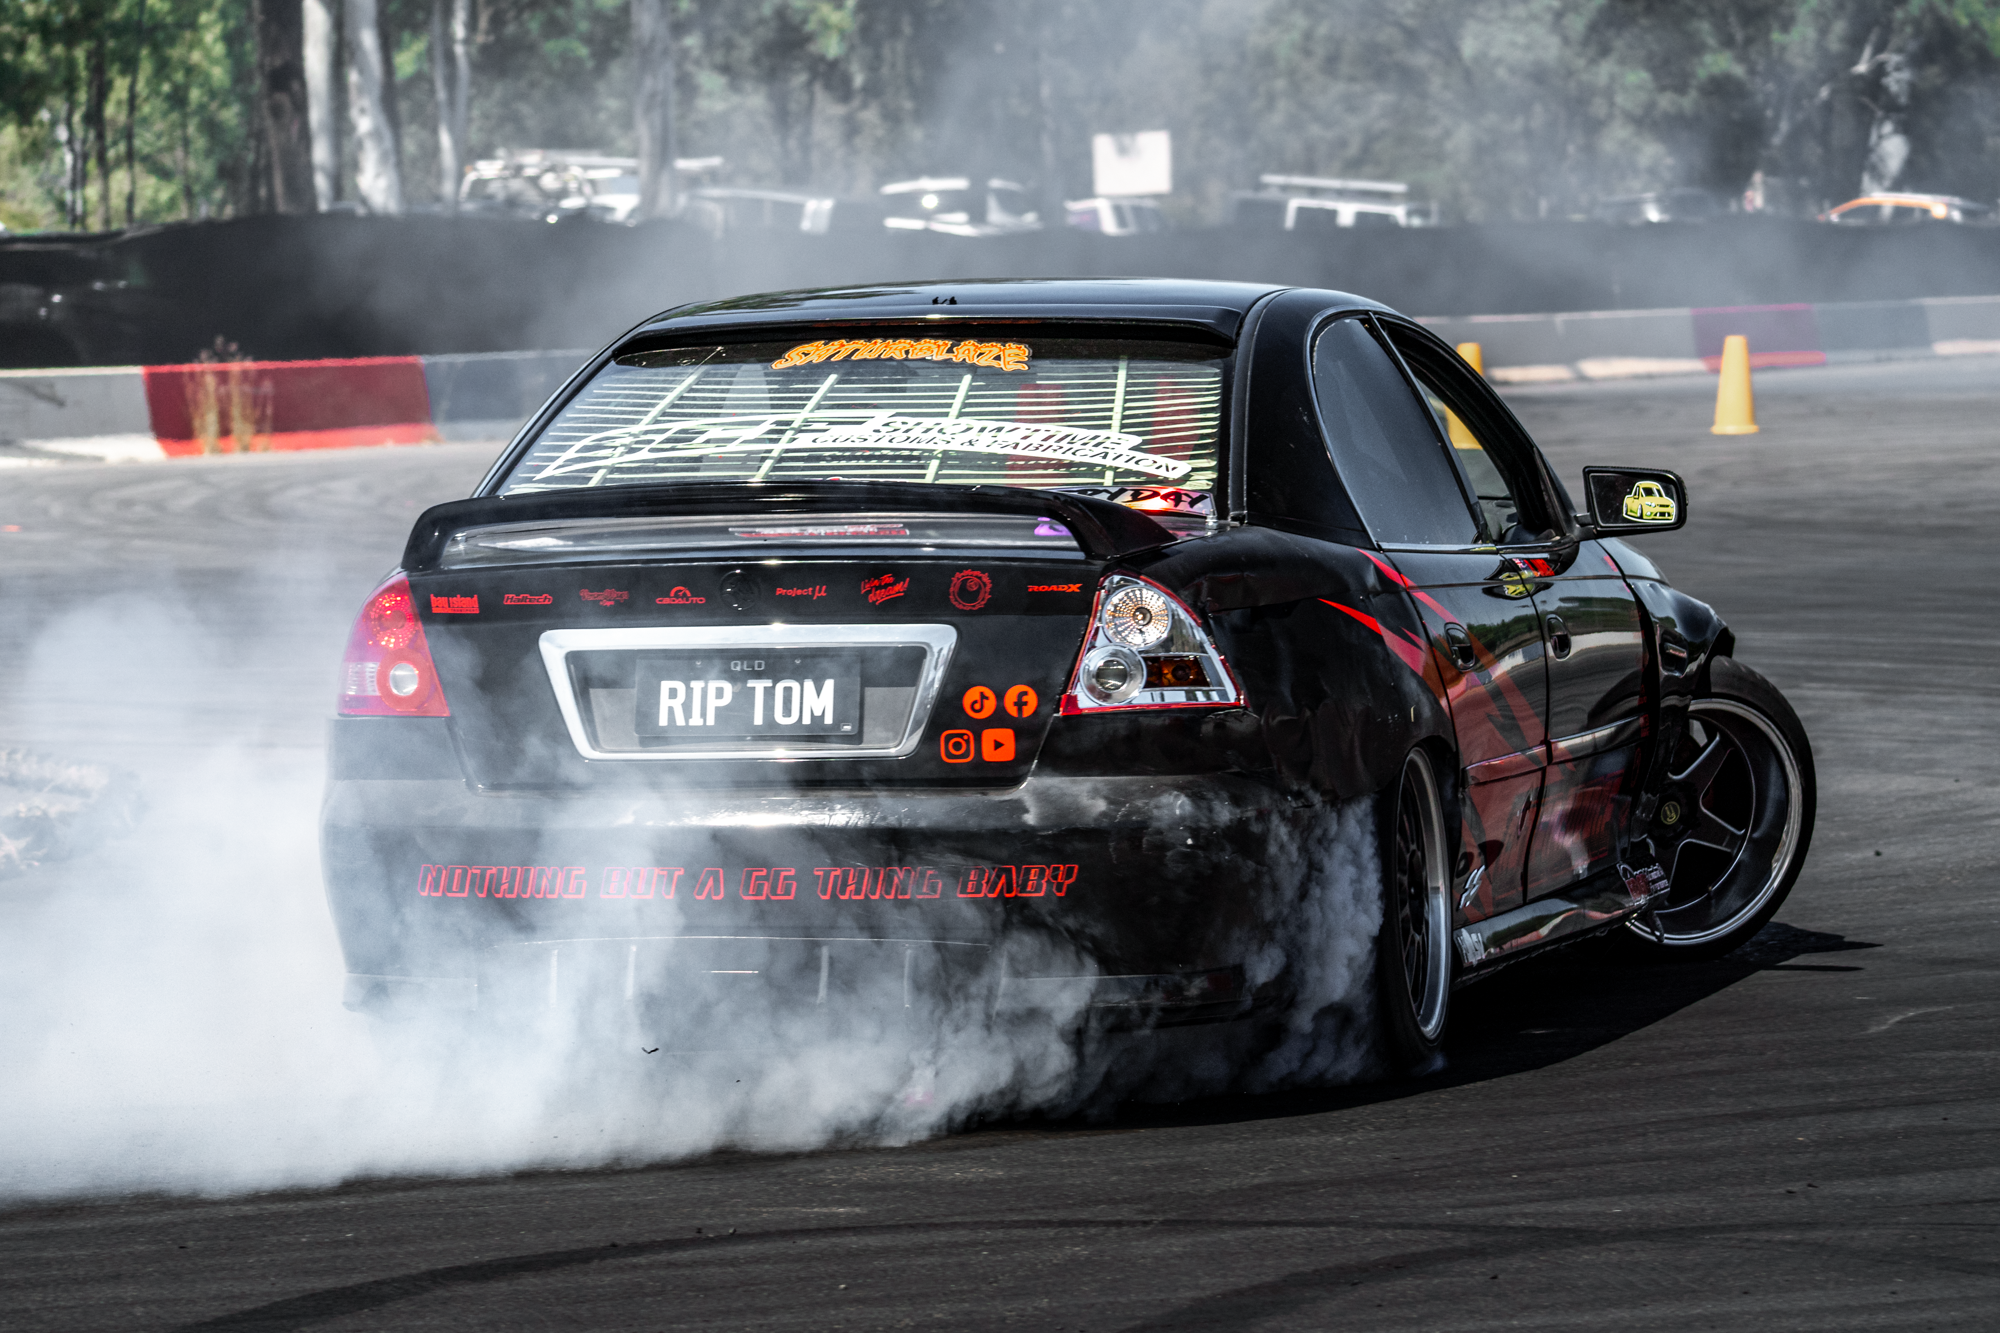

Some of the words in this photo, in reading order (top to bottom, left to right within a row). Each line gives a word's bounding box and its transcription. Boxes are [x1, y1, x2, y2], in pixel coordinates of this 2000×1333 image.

[872, 420, 1131, 449] SHOWTIME
[811, 434, 956, 445] CUSTOMS
[985, 440, 1178, 473] FABRICATION
[775, 587, 813, 597] Project
[1027, 583, 1083, 593] ROADX
[503, 594, 553, 605] Haltech
[730, 660, 766, 671] QLD
[658, 680, 733, 726] RIP
[747, 679, 834, 725] TOM
[417, 864, 587, 899] NOTHING
[600, 866, 684, 899] BUT
[693, 867, 725, 900] A
[739, 867, 797, 900] GG
[813, 866, 942, 900] THING
[956, 864, 1079, 898] BABY
